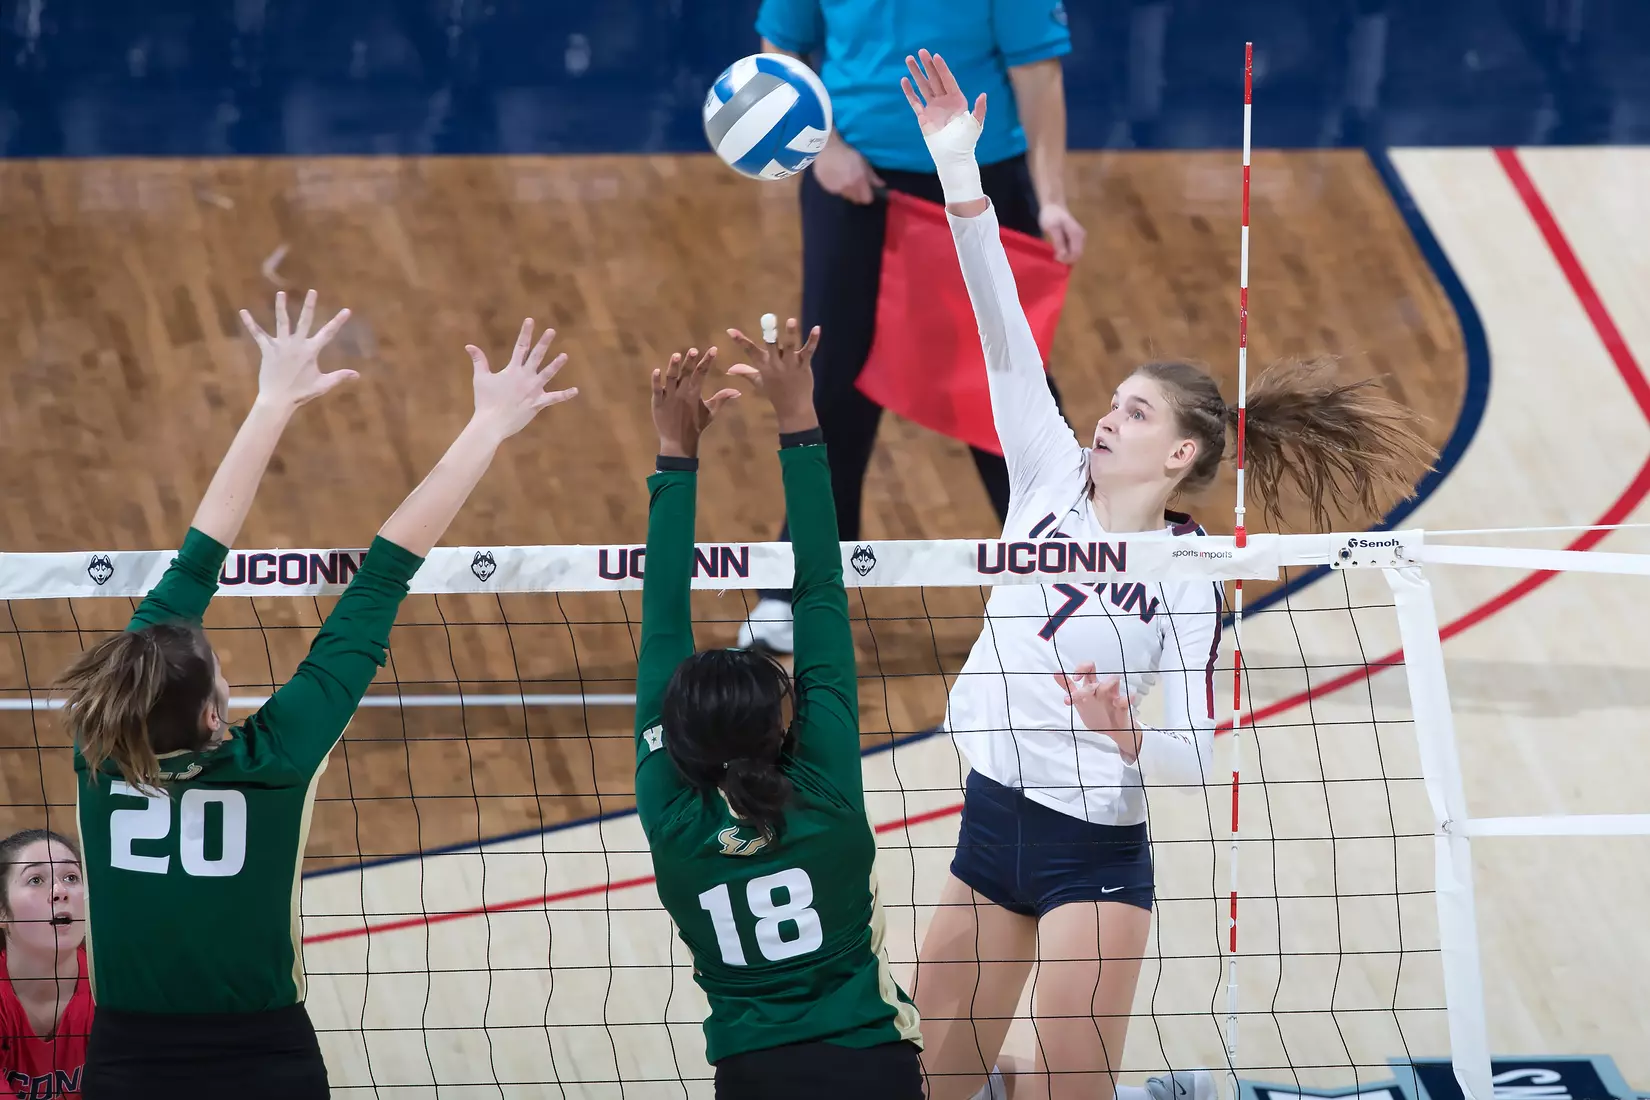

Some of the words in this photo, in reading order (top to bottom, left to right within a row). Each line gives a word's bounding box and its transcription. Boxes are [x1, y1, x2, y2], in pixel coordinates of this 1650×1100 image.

[977, 541, 1127, 575] UCONN
[1172, 549, 1199, 558] sports
[1199, 550, 1233, 560] imports
[1359, 538, 1400, 548] Senoh
[219, 552, 368, 585] UCONN
[599, 546, 749, 580] UCNN
[1037, 583, 1089, 642] 7
[109, 779, 247, 877] 20
[698, 868, 823, 966] 18
[3, 1064, 85, 1100] CON
